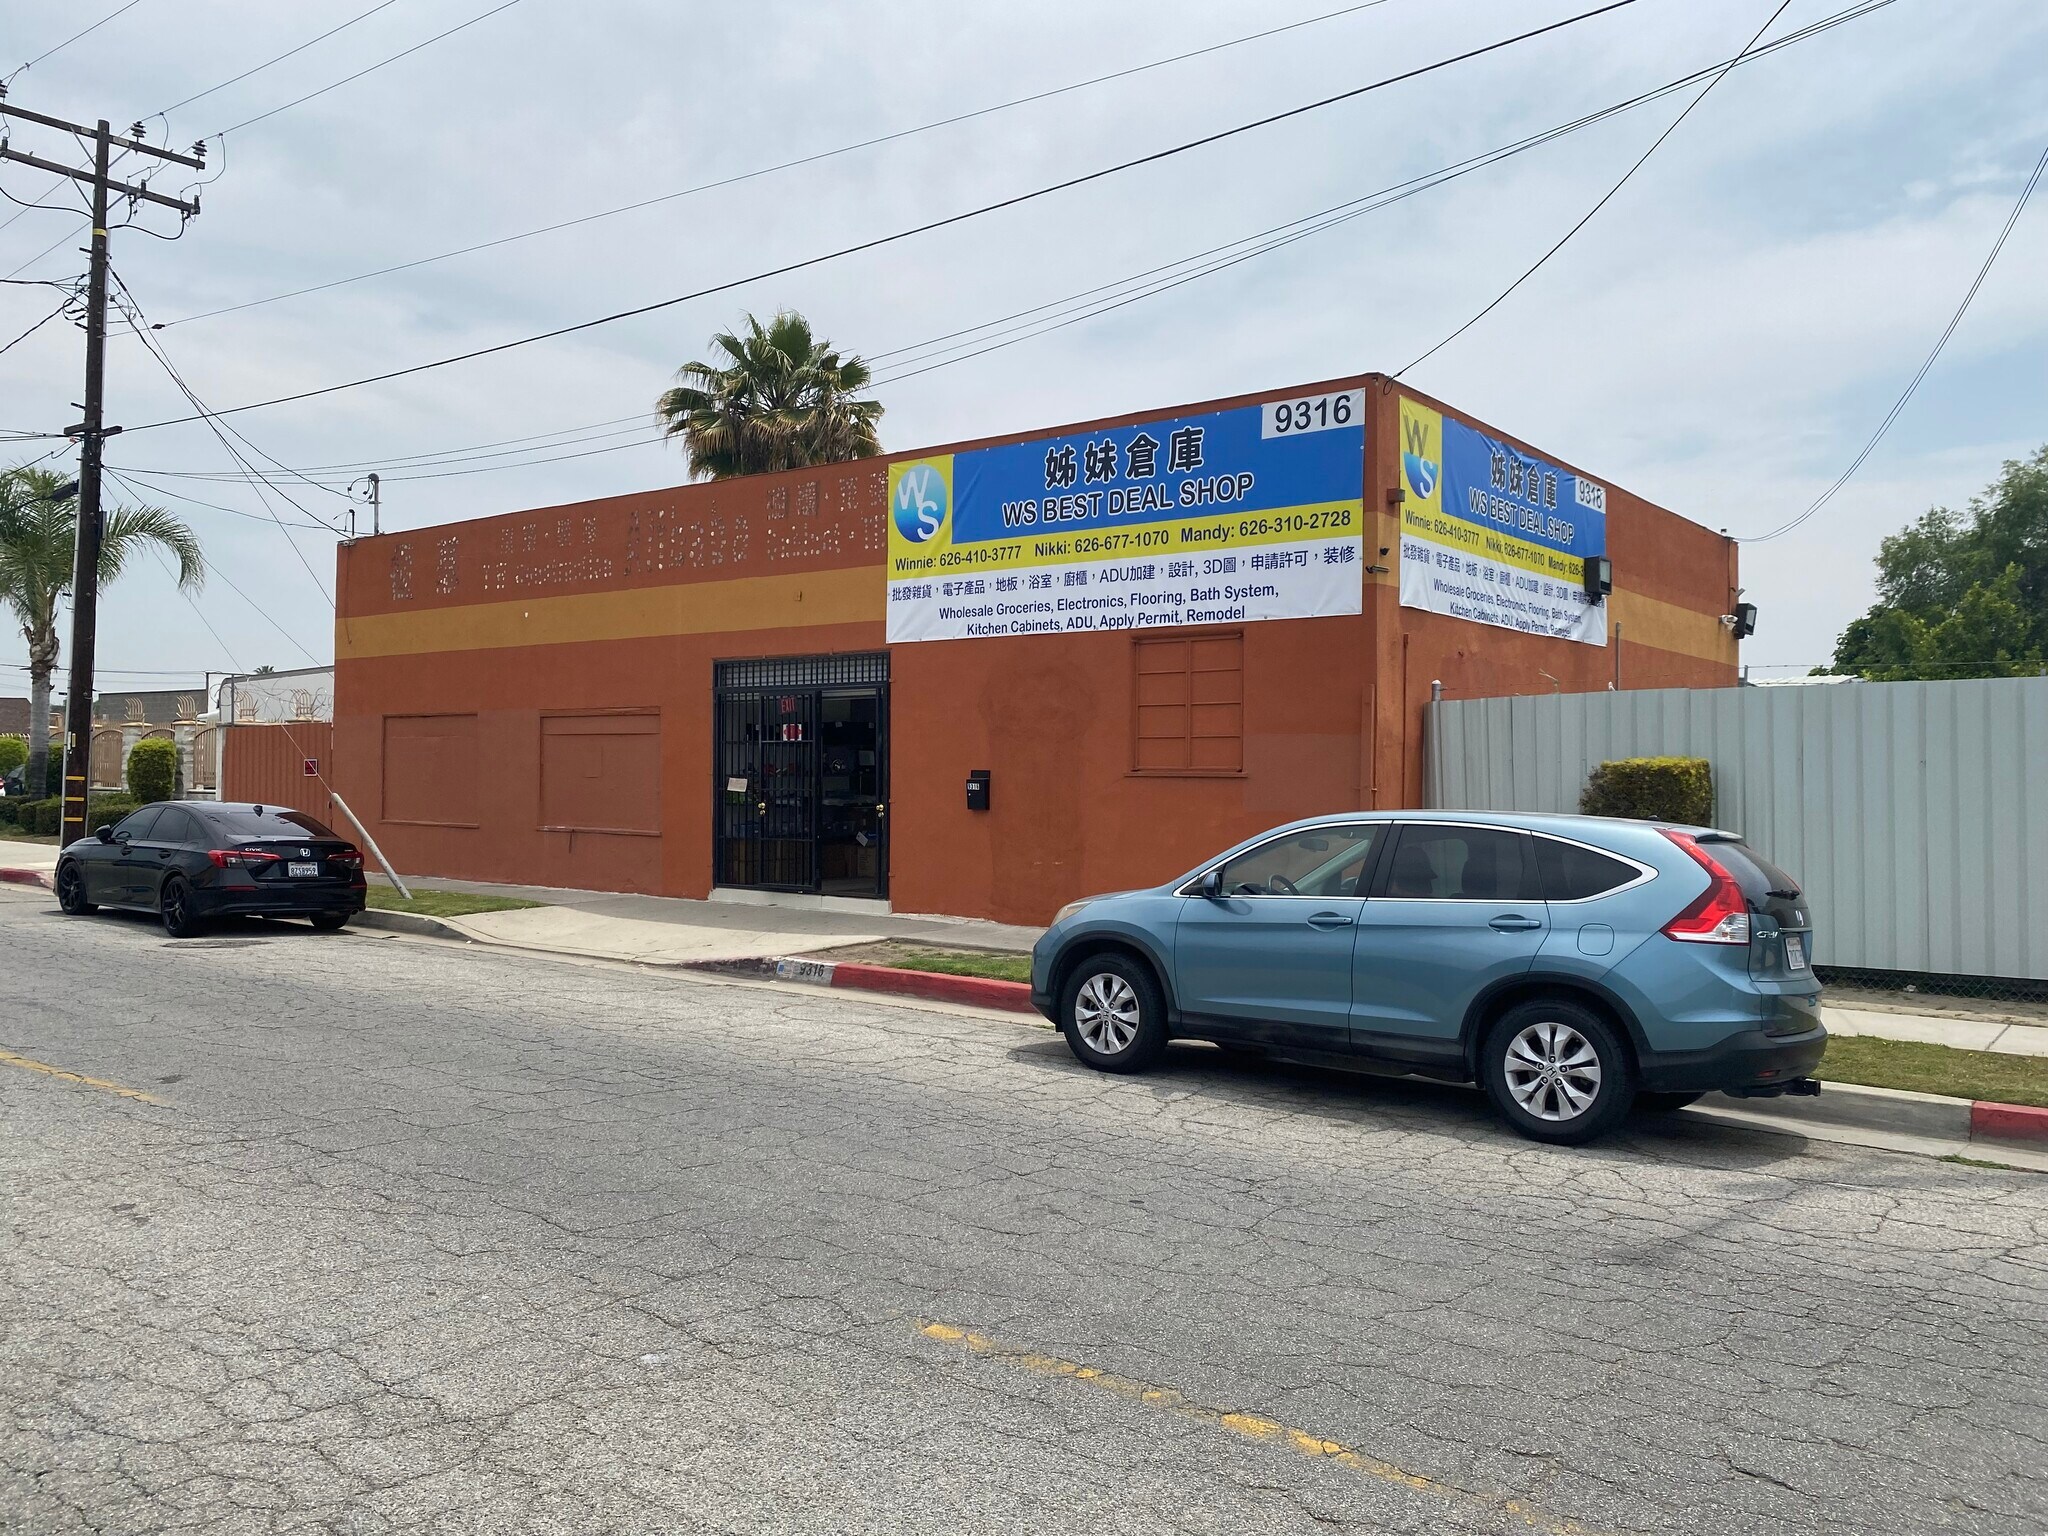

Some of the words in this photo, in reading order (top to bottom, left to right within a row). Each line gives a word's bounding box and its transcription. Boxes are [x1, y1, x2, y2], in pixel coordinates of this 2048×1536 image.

[1275, 395, 1351, 433] 9316
[1045, 427, 1204, 490] 姊妹倉庫
[1003, 500, 1037, 527] WS
[1043, 492, 1103, 522] BEST
[1108, 483, 1173, 515] DEAL
[1179, 472, 1254, 506] SHOP
[1469, 486, 1487, 516] WS
[1490, 495, 1518, 527] BEST
[1519, 506, 1546, 537] DEAL
[1548, 516, 1574, 545] SHOP
[895, 556, 936, 571] Winnie:
[940, 545, 1022, 567] 626-410-3777
[1035, 541, 1071, 557] Nikki:
[1075, 530, 1169, 553] 626-677-1070
[1180, 524, 1235, 543] Mandy:
[1239, 510, 1352, 536] 626-310-2728
[1405, 509, 1433, 531] Winnie:
[1434, 519, 1480, 546] 626-410-3777
[939, 605, 993, 620] Wholesale
[996, 601, 1054, 616] Groceries,
[1057, 595, 1127, 611] Electronics,
[1130, 591, 1186, 607] Flooring,
[1191, 587, 1220, 602] Bath
[1224, 583, 1279, 602] System,
[1433, 578, 1464, 597] Wholesale
[967, 623, 1007, 636] Kitchen
[1010, 618, 1063, 634] Cabinets,
[1066, 616, 1097, 630] ADU,
[1100, 613, 1134, 630] Apply
[1138, 610, 1183, 626] Permit,
[1187, 605, 1245, 622] Remodel
[1450, 602, 1472, 620] Kitchen
[1515, 618, 1530, 633] Apply
[799, 962, 825, 978] 9316
